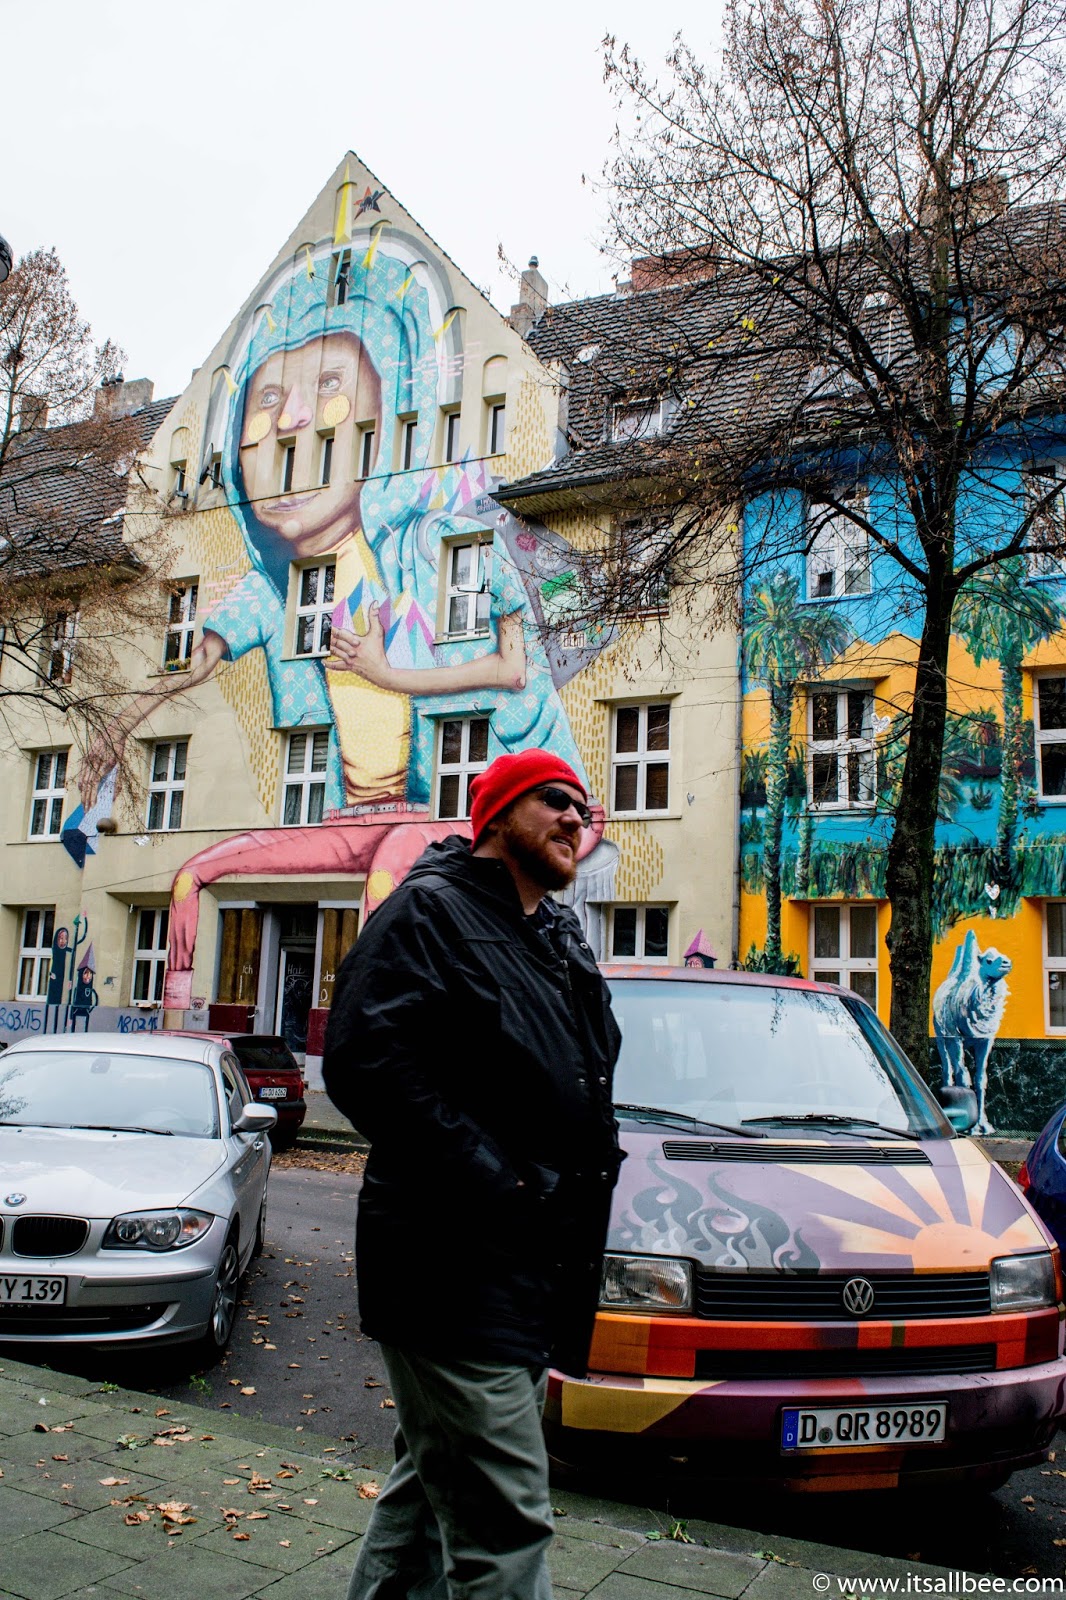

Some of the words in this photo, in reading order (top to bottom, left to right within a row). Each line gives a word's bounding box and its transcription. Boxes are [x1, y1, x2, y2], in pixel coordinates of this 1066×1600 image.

[21, 1279, 63, 1301] 139
[799, 1414, 817, 1443] D
[836, 1411, 870, 1441] QR
[876, 1409, 941, 1438] 8989
[786, 1433, 793, 1442] D
